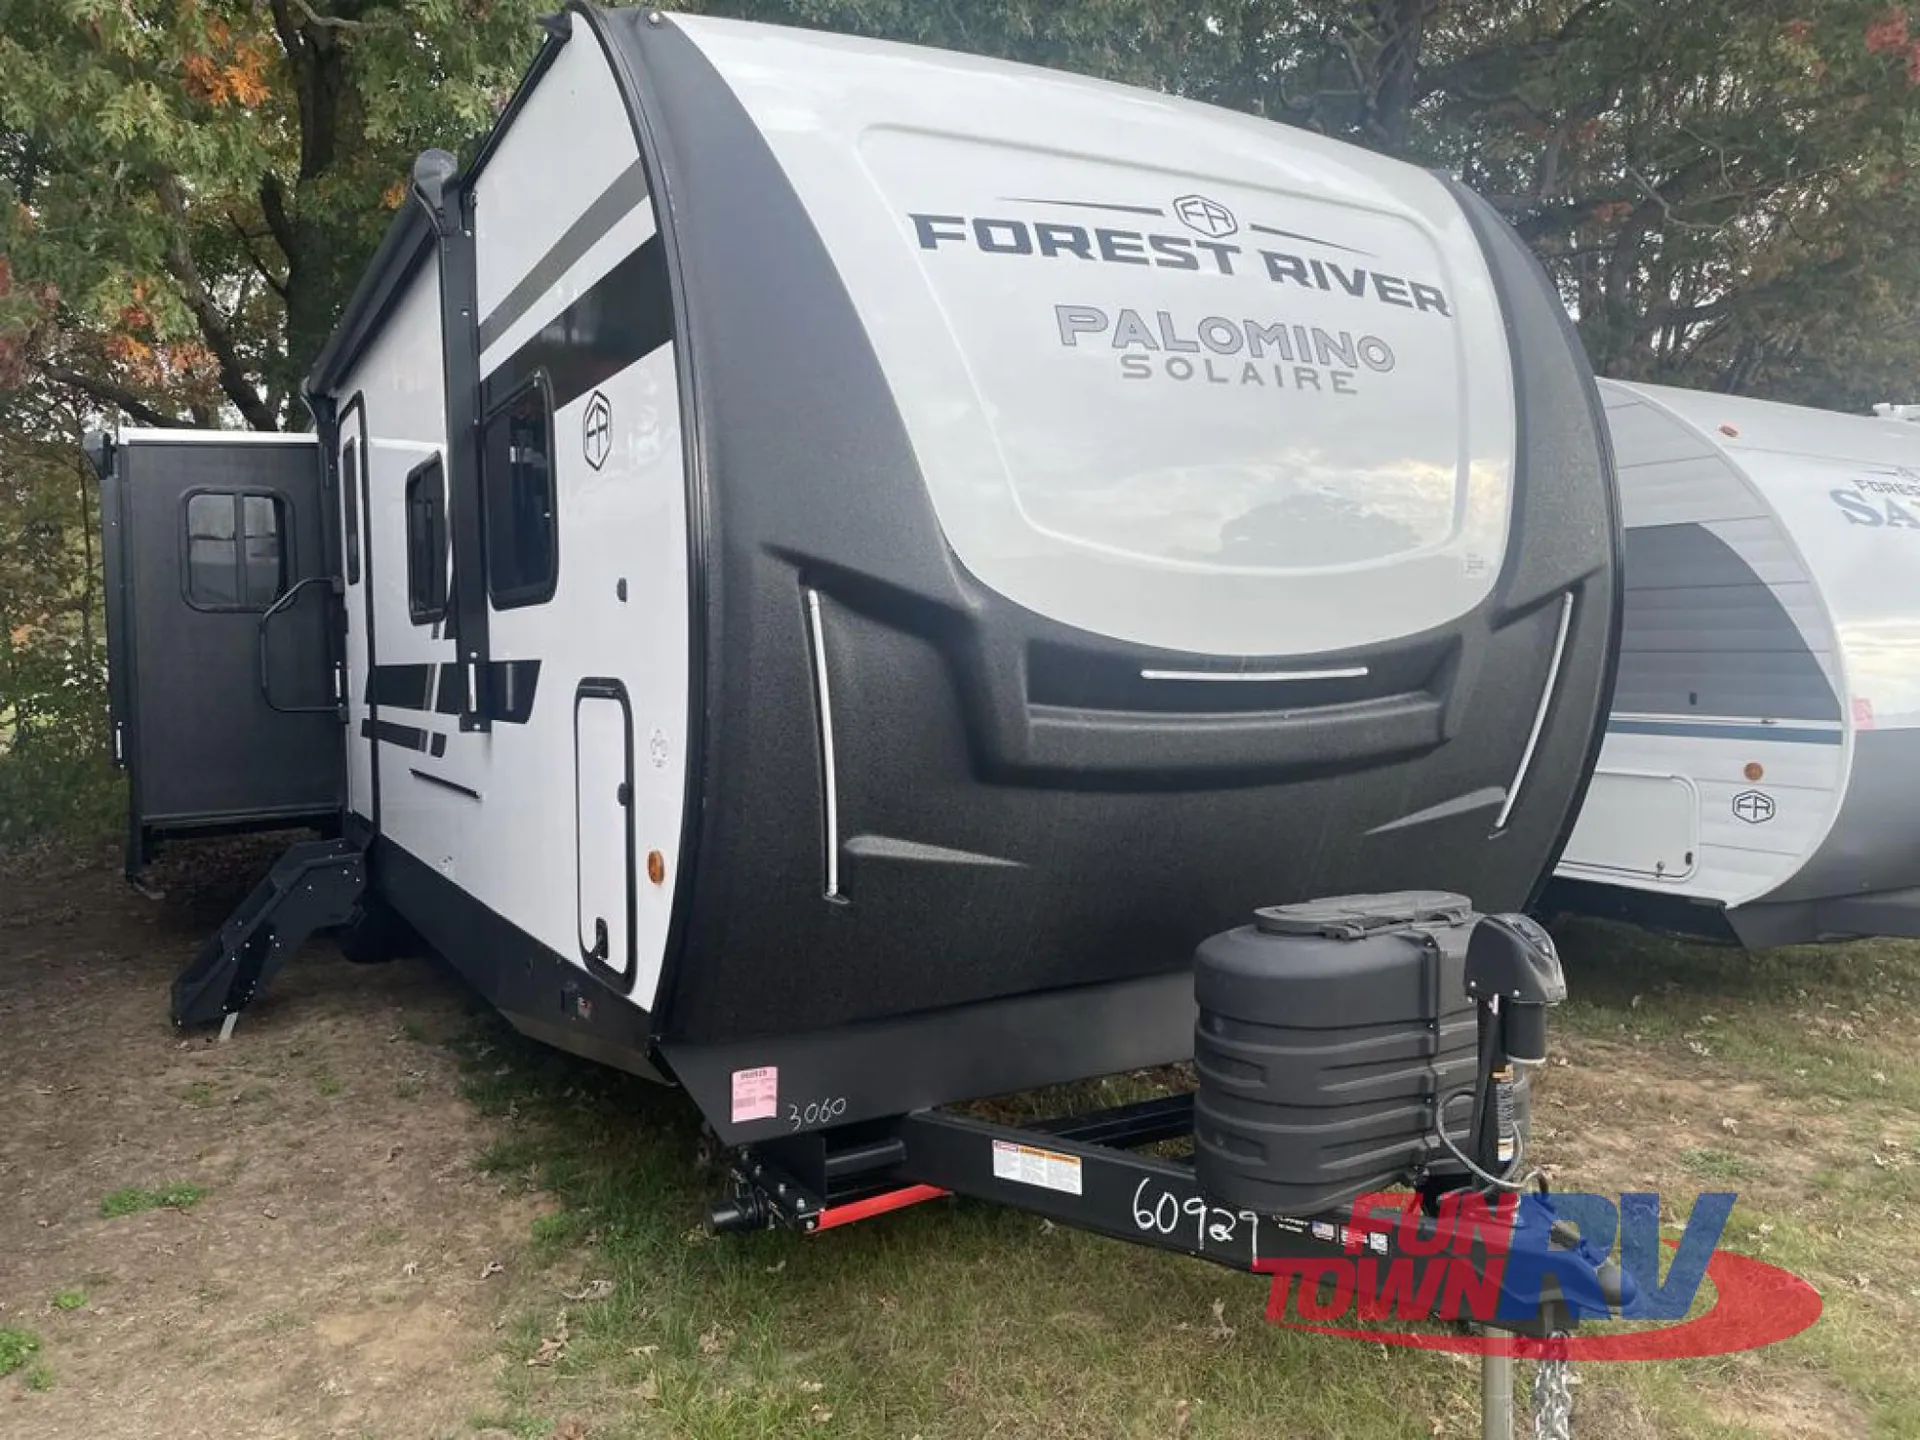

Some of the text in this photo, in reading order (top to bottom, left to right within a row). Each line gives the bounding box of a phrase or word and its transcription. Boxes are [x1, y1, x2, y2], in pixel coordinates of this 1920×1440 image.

[908, 212, 1452, 317] FOREST RIVER
[1054, 304, 1396, 373] PALOMINO
[1121, 353, 1358, 395] SOLAIRE
[1829, 488, 1920, 529] SA
[788, 1098, 847, 1131] 3060
[1133, 1177, 1259, 1267] 60929
